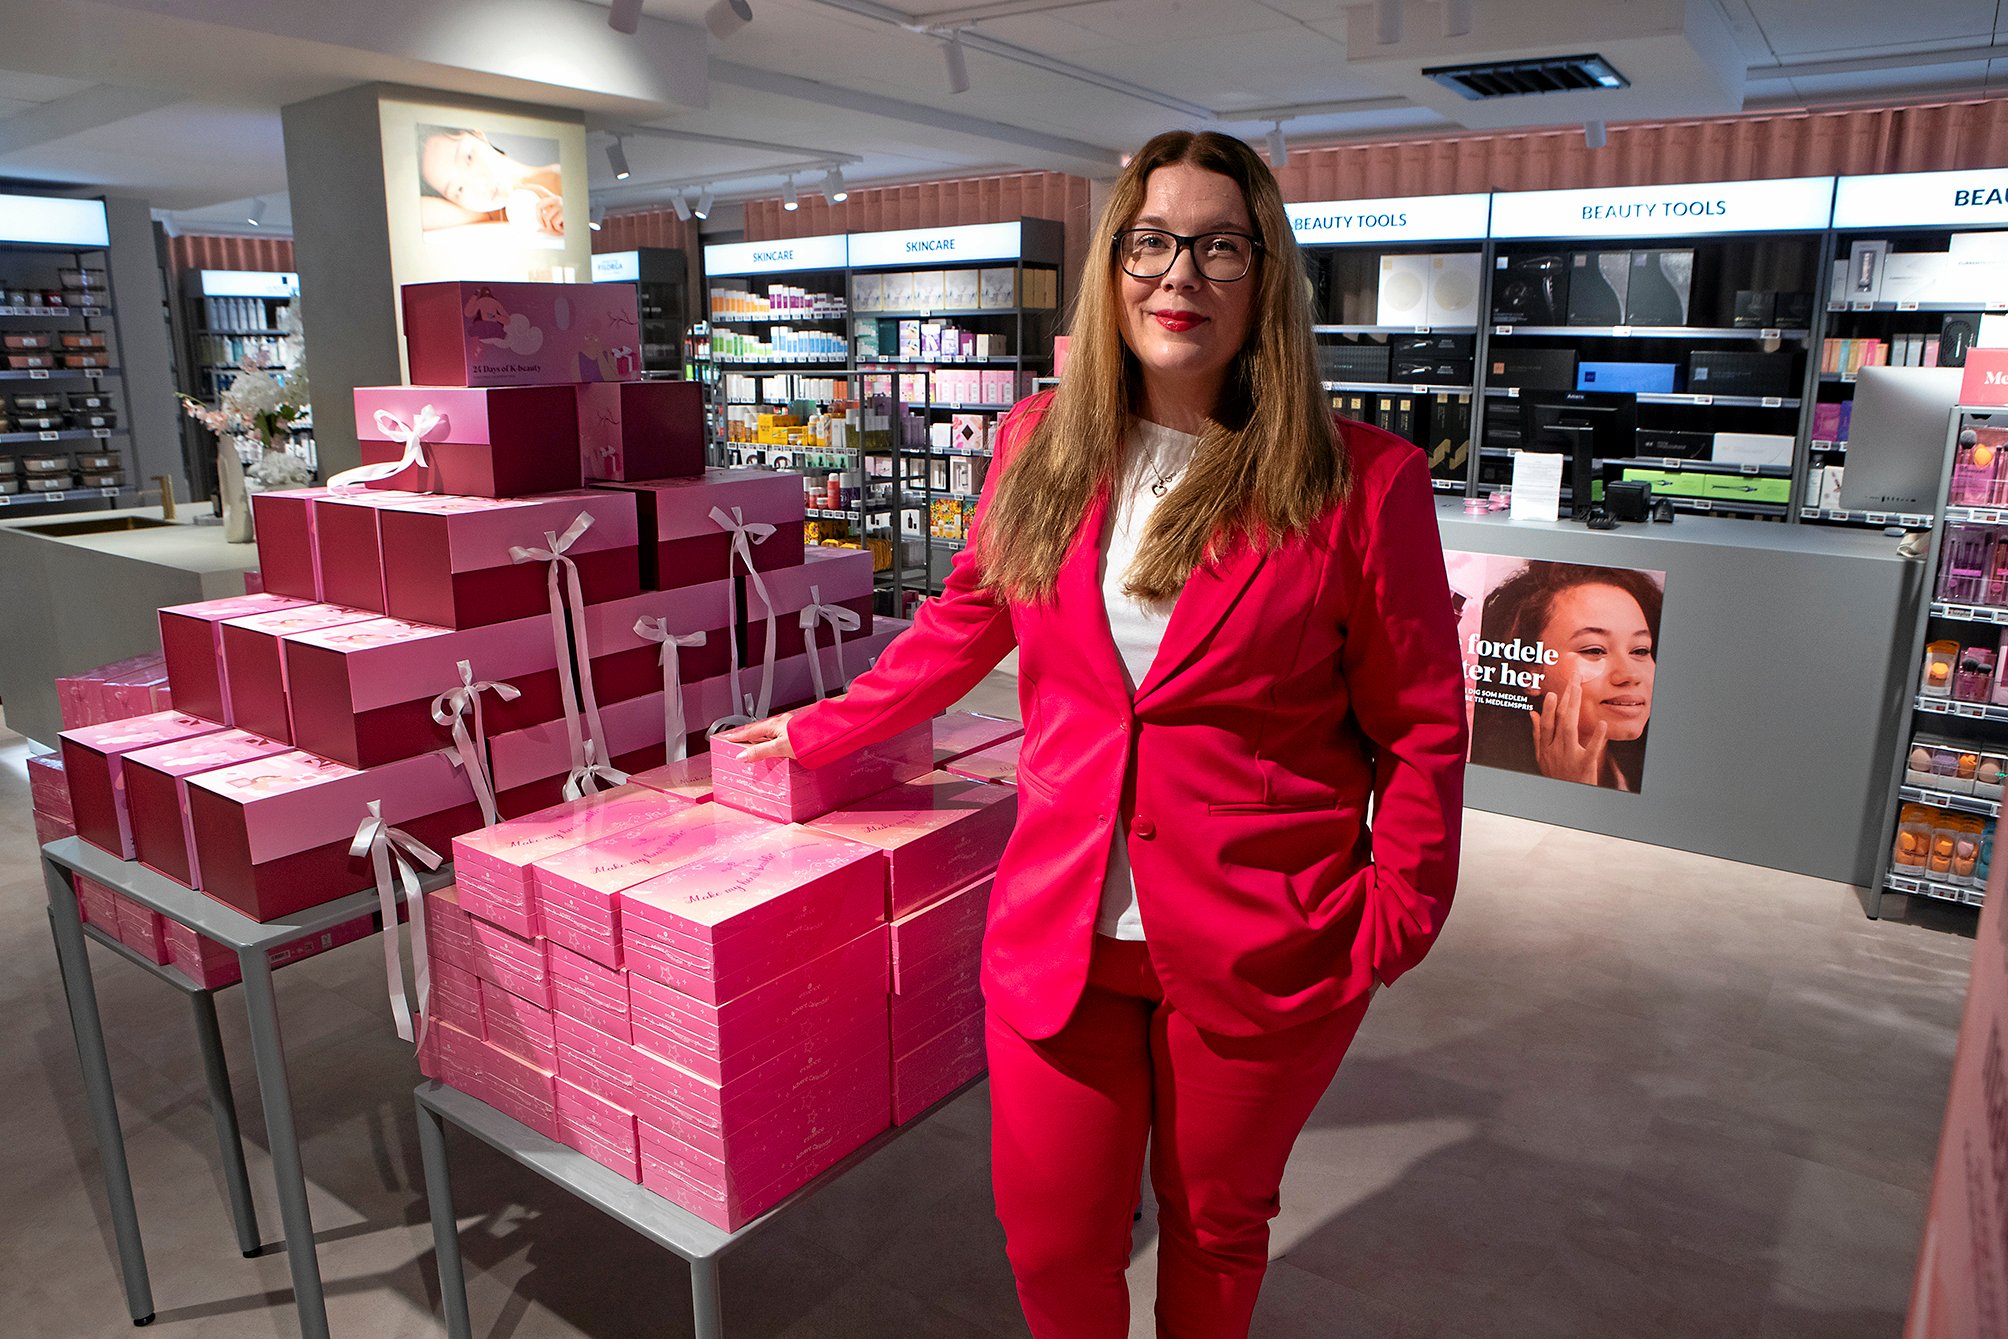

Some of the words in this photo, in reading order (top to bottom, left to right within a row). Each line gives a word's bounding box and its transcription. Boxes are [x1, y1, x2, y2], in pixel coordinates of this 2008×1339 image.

[1954, 188, 2008, 206] BEA
[1582, 203, 1656, 219] BEAUTY
[1662, 200, 1726, 216] TOOLS
[1294, 216, 1353, 230] BEAUTY
[1357, 213, 1407, 227] TOOLS
[905, 239, 955, 252] SKINCARE
[753, 250, 794, 262] SKINCARE
[483, 365, 500, 374] Days
[510, 364, 540, 373] K-beauty
[1467, 633, 1559, 666] fordele
[1499, 662, 1545, 690] her
[1481, 690, 1497, 698] SOM
[1498, 693, 1528, 702] MEDLEM
[1485, 698, 1533, 711] MEDLEMSPRIS
[592, 864, 624, 874] Make
[687, 891, 721, 904] Make
